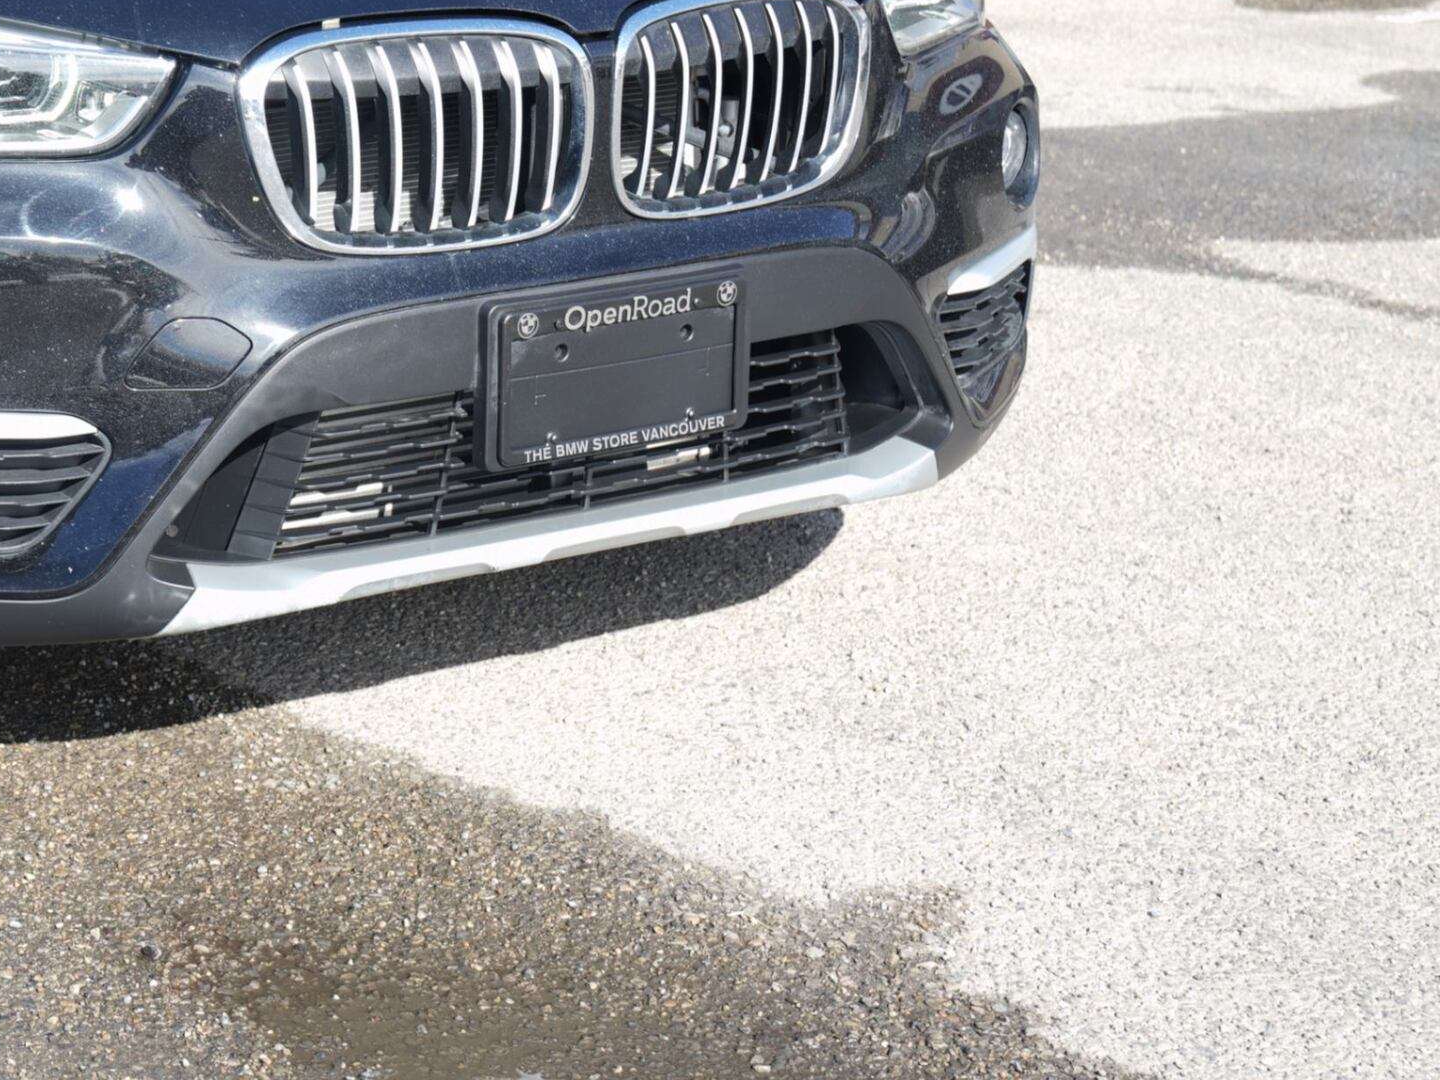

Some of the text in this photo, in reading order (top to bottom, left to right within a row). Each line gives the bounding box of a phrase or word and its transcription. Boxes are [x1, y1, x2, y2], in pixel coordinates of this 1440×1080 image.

[564, 287, 691, 333] OpenRoad
[524, 415, 725, 464] THE BMW STORE VANCOUVER
